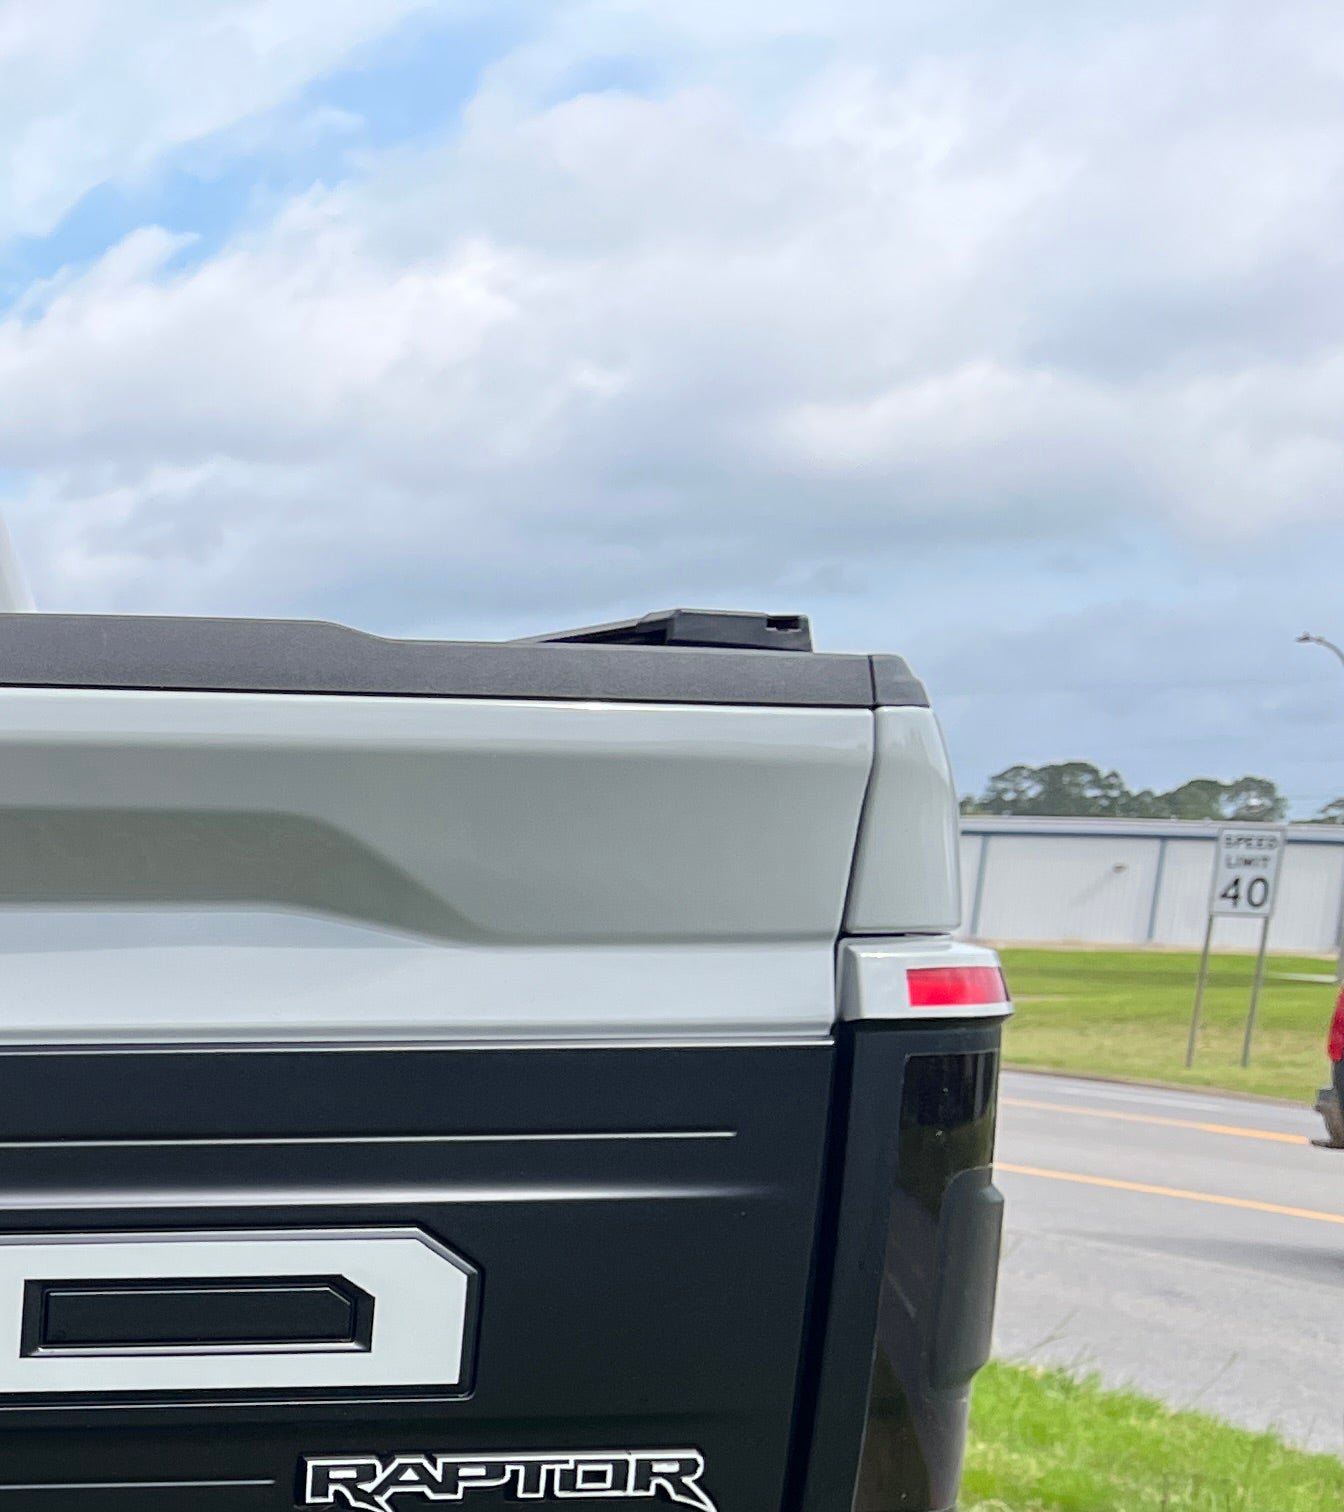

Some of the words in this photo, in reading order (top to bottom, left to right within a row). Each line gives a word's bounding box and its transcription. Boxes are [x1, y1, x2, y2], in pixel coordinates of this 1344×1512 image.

[1224, 834, 1278, 850] SPEED
[1225, 854, 1270, 870] LIMIT
[1220, 877, 1269, 908] 40
